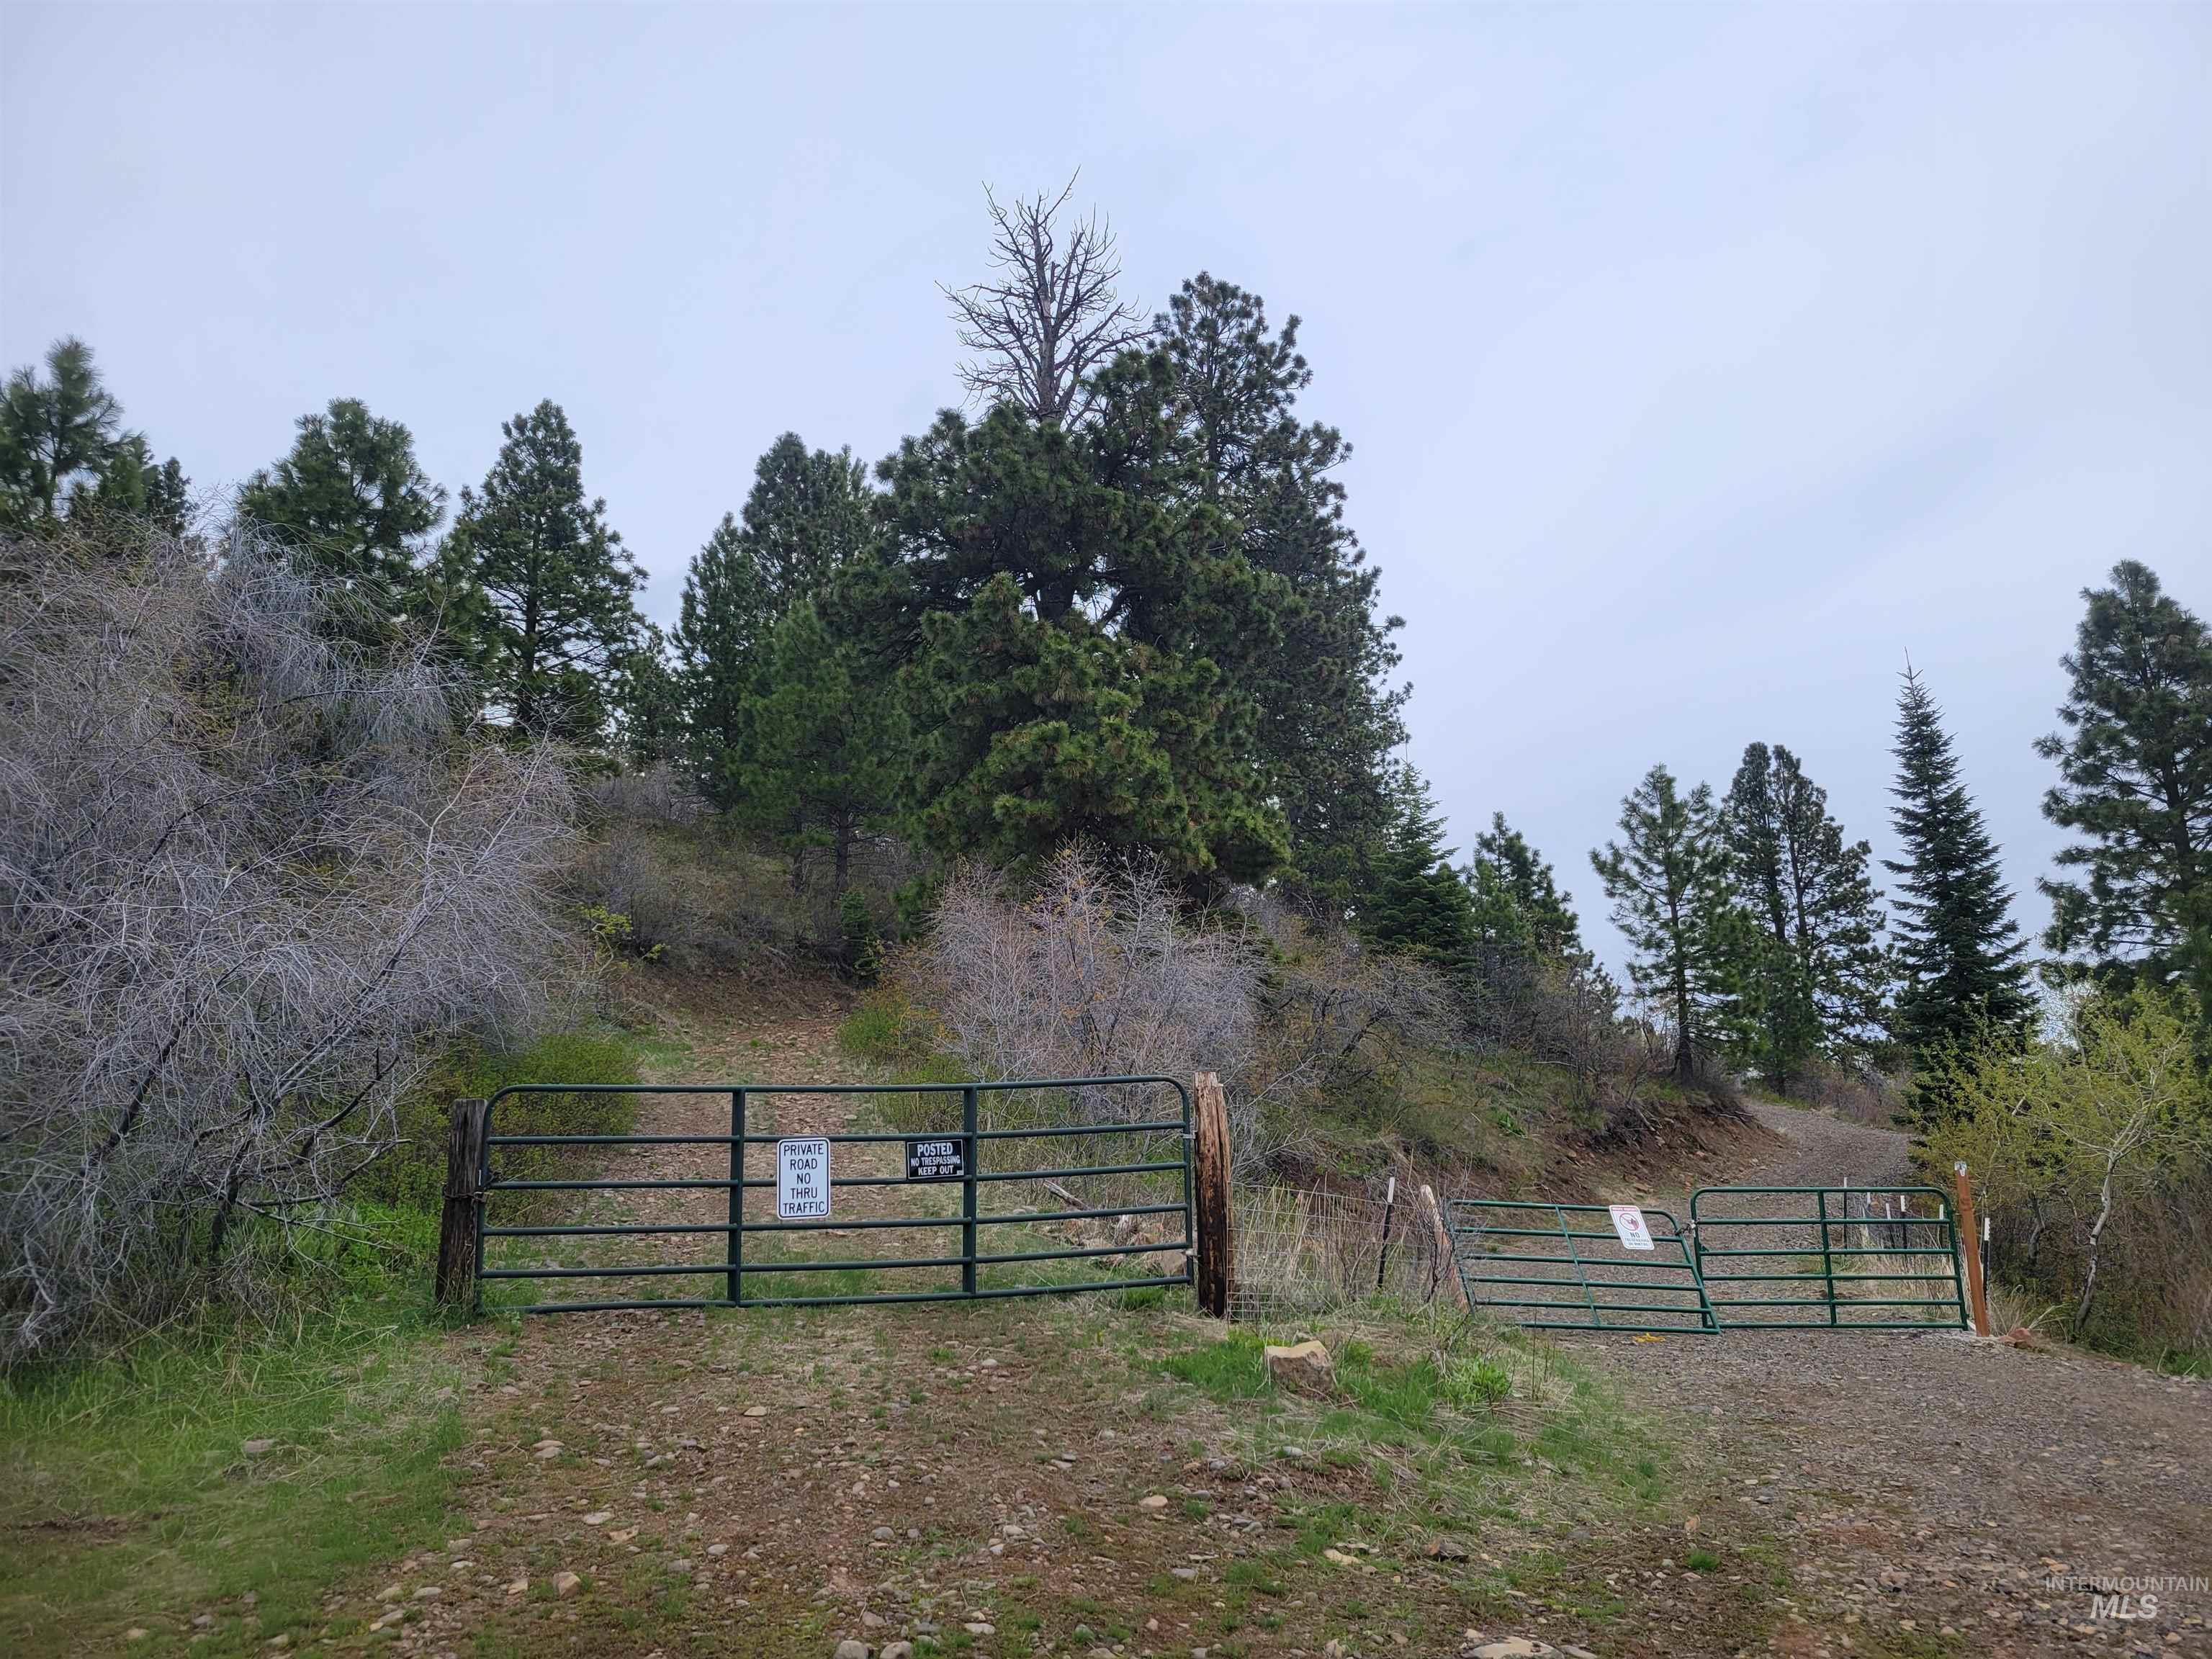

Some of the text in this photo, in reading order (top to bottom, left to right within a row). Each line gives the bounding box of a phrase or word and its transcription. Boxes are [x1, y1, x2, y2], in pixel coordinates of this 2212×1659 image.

[783, 1143, 824, 1156] PRIVATE
[917, 1142, 953, 1156] POSTED
[790, 1158, 818, 1170] ROAD
[910, 1155, 961, 1166] NO TRESPASSING
[918, 1164, 954, 1176] KEEP OUT
[796, 1172, 811, 1184] NO
[790, 1187, 818, 1200] THRU
[783, 1201, 824, 1214] TRAFFIC
